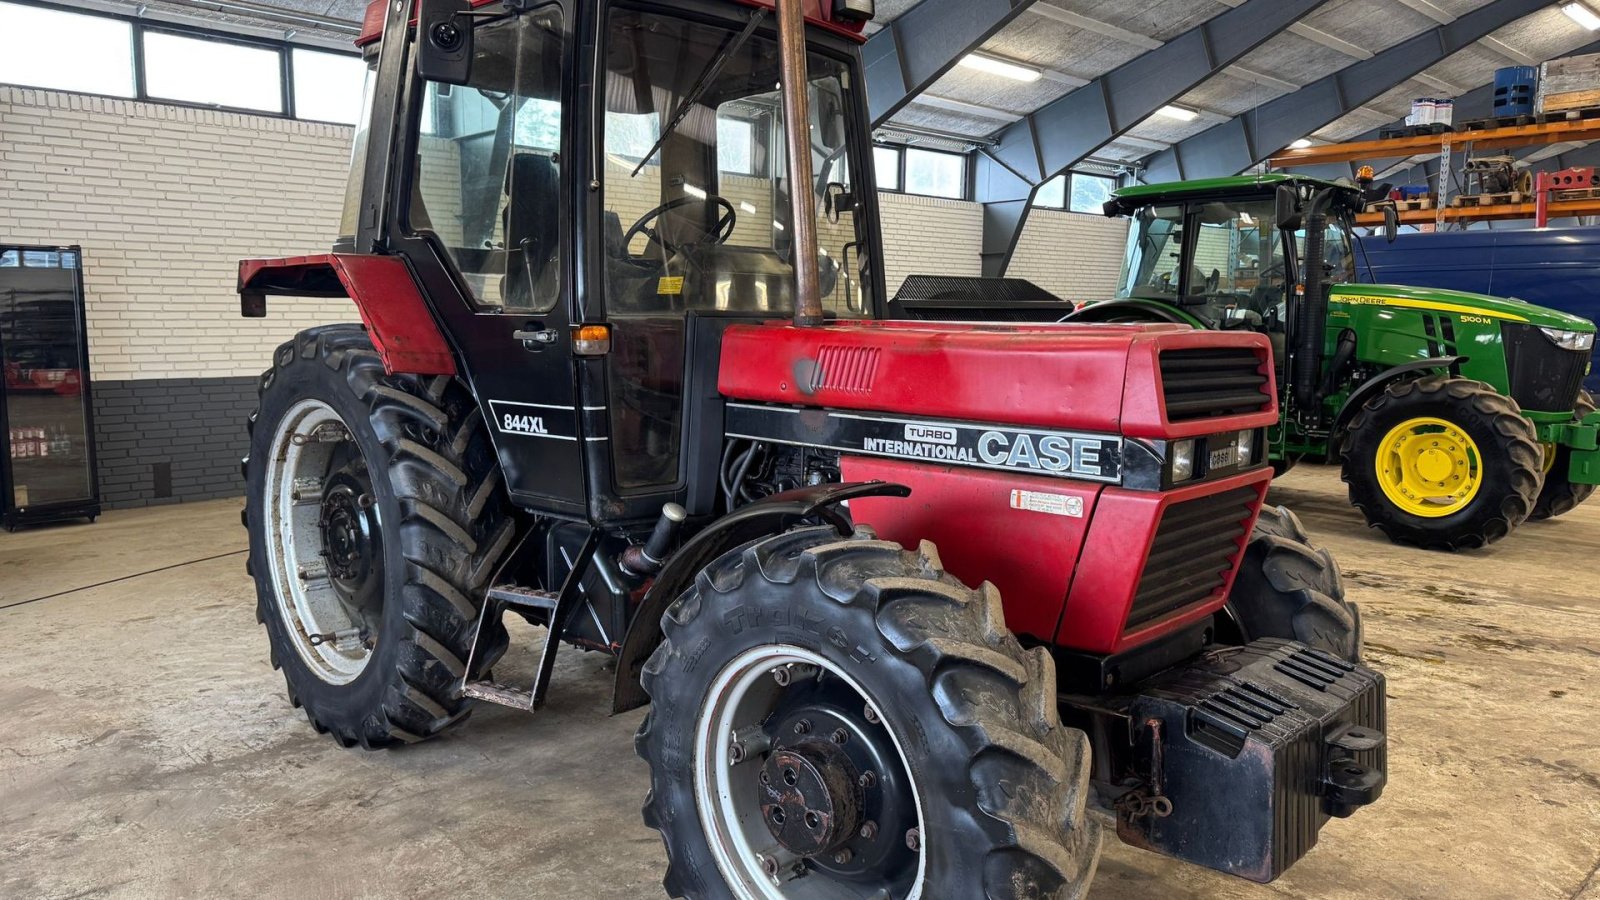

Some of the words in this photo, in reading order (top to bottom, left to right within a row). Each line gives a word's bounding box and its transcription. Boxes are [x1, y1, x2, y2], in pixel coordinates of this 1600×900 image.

[1339, 295, 1359, 304] JOHN
[1360, 296, 1386, 305] DEERE
[1460, 315, 1482, 324] 5100
[504, 413, 548, 434] 844XL
[909, 427, 953, 440] TURBO
[863, 437, 977, 463] INTERNATIONAL
[977, 431, 1102, 475] CASE
